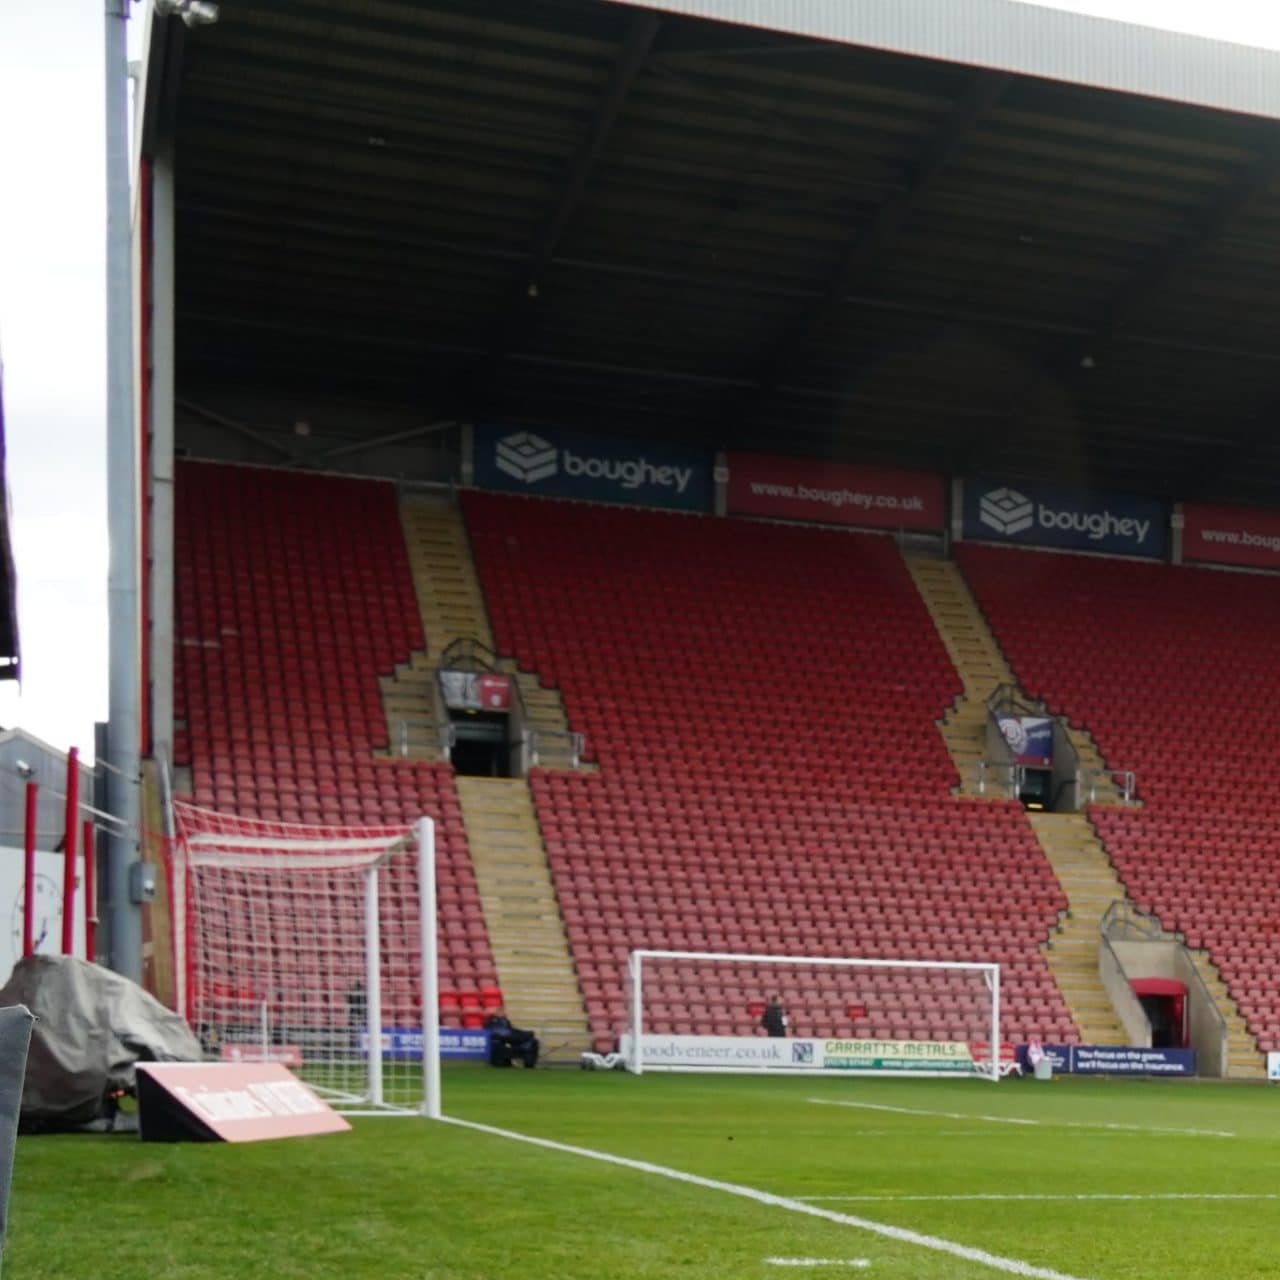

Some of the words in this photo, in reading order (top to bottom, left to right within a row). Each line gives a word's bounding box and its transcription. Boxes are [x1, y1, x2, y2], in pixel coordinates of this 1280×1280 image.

[564, 450, 692, 492] boughey
[751, 481, 923, 512] www.boughey.co.uk
[1039, 504, 1149, 543] boughey
[642, 1043, 781, 1059] oodveneer.co.uk
[826, 1042, 899, 1054] GARRATT'S
[904, 1043, 956, 1056] METALS
